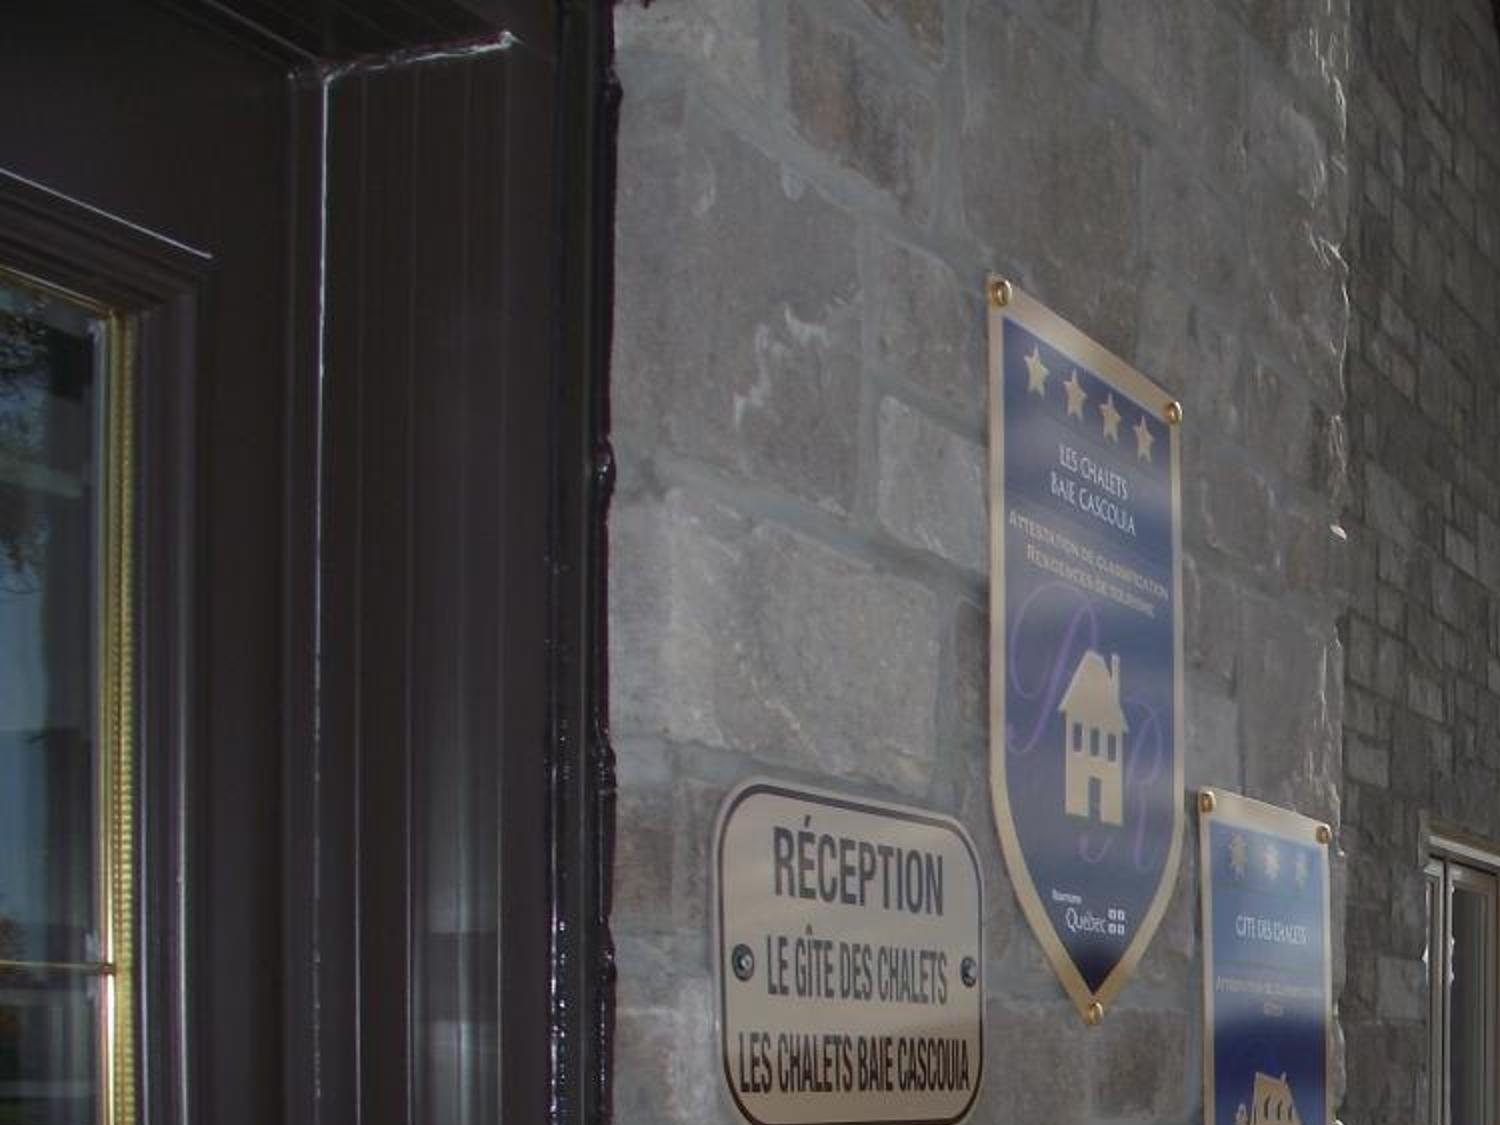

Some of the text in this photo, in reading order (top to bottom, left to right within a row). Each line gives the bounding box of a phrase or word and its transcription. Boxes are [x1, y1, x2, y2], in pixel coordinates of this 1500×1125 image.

[1050, 471, 1137, 537] BAIE CASCOUIA
[1059, 442, 1129, 502] LES CHALETS
[773, 815, 944, 916] RÉCEPTION
[766, 925, 948, 1006] LE GÎTE DES CHALETS
[738, 1032, 971, 1093] LES CHALETS BAIE CASCOUIA
